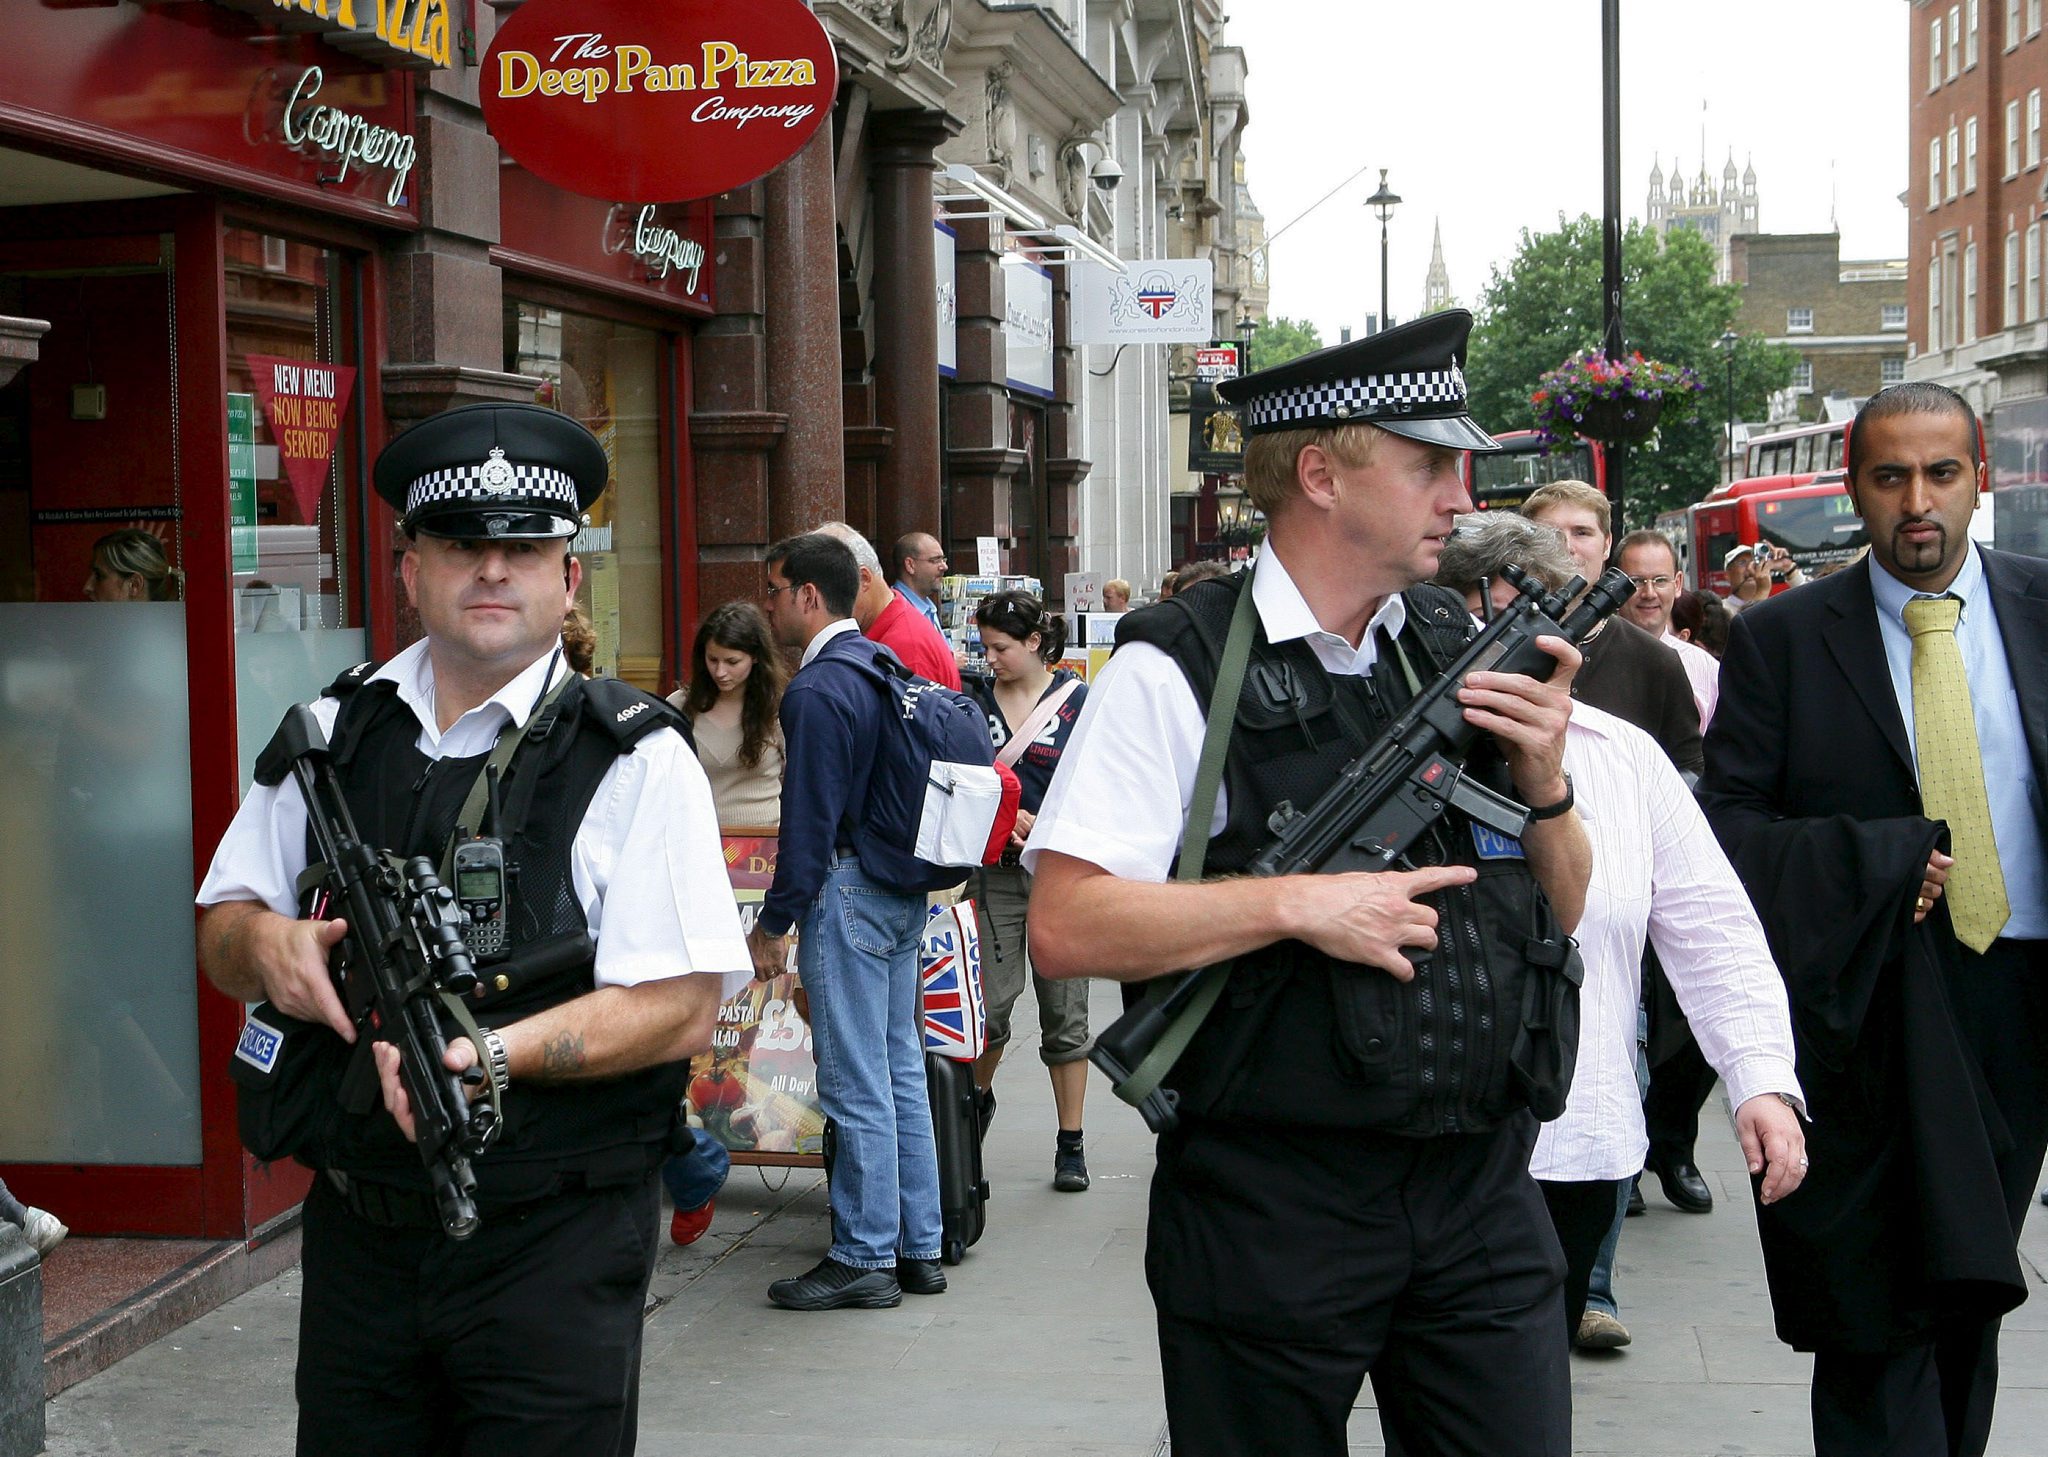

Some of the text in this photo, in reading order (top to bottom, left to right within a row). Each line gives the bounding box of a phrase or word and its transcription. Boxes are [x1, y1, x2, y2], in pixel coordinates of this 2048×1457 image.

[550, 32, 612, 63] The
[497, 40, 816, 104] Deep Pan Pizza
[690, 96, 814, 130] Company
[274, 364, 335, 399] NEW MENU
[274, 397, 337, 429] NOW BEING
[284, 429, 329, 459] SERVED!
[1792, 551, 1817, 560] DRIVER
[617, 701, 650, 722] 4904
[1028, 744, 1062, 758] LINEUP
[717, 1005, 756, 1023] PASTA
[242, 1026, 274, 1059] POLICE
[770, 1075, 787, 1092] All
[788, 1077, 812, 1096] Day
